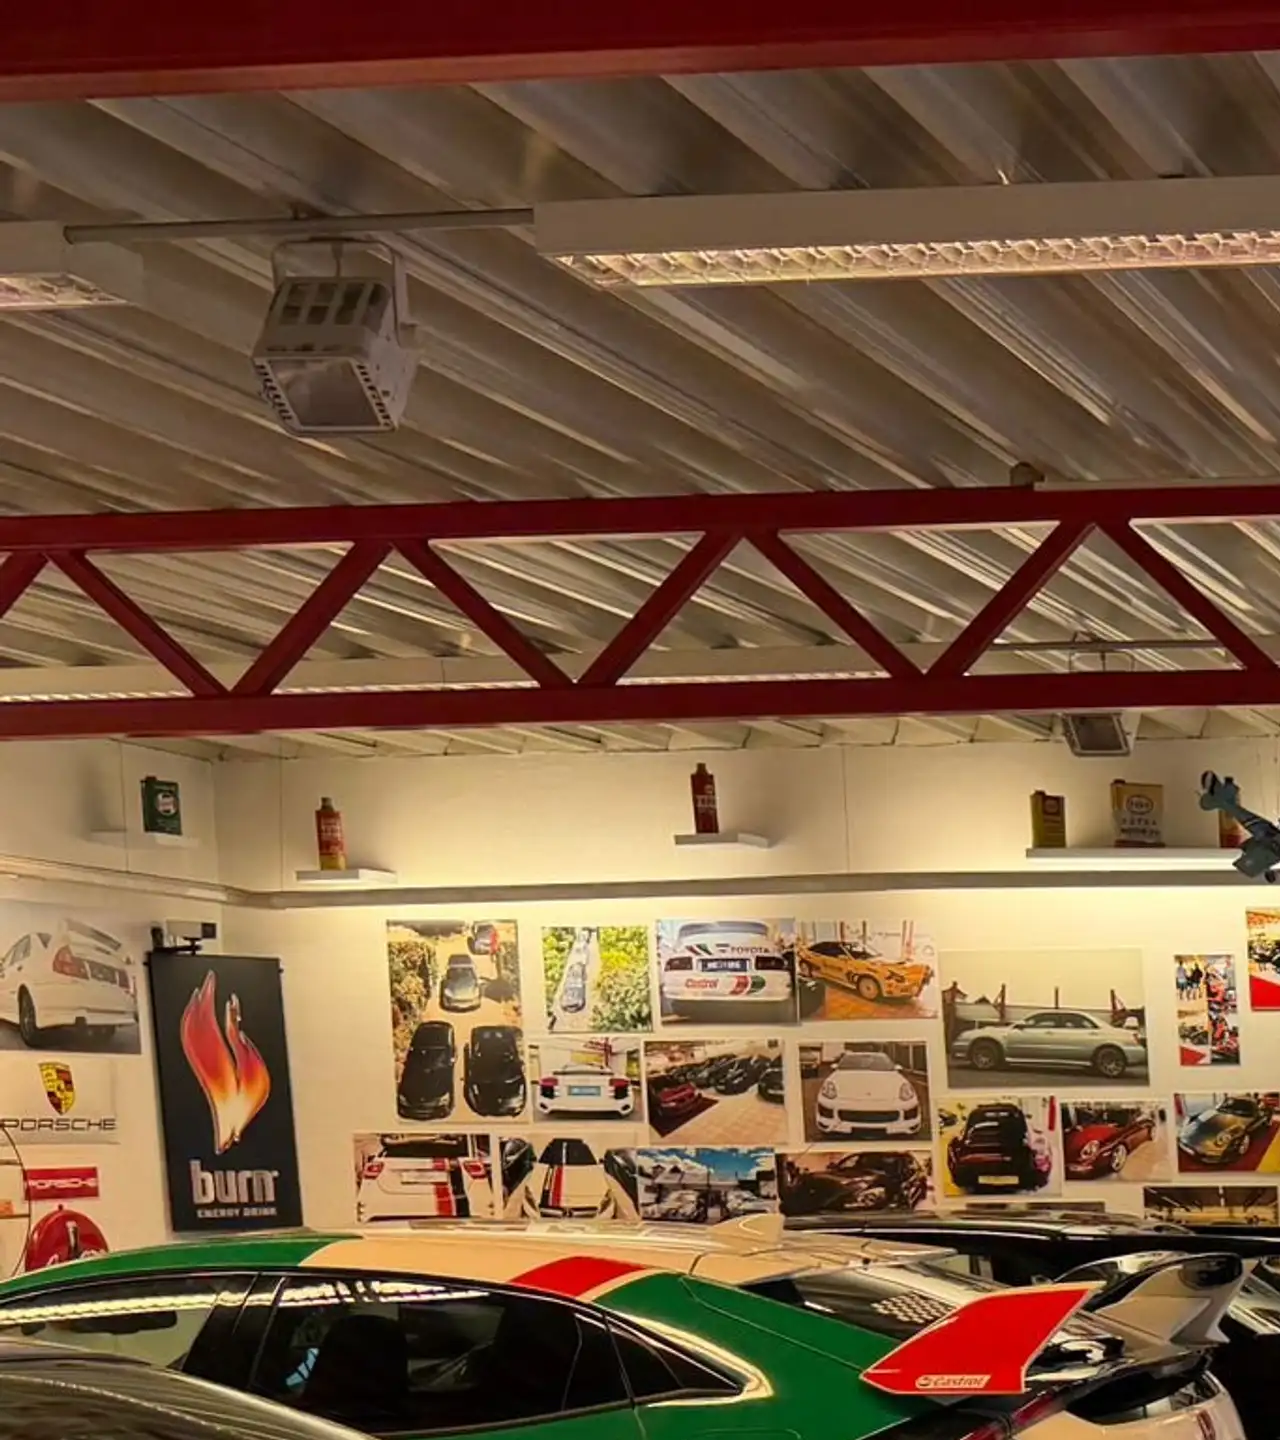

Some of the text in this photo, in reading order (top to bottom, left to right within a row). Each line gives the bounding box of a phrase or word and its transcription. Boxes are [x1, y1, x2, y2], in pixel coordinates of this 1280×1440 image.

[2, 1117, 117, 1132] PORSCHE
[189, 1158, 276, 1205] burn
[197, 1206, 277, 1218] ENERGY DRINK
